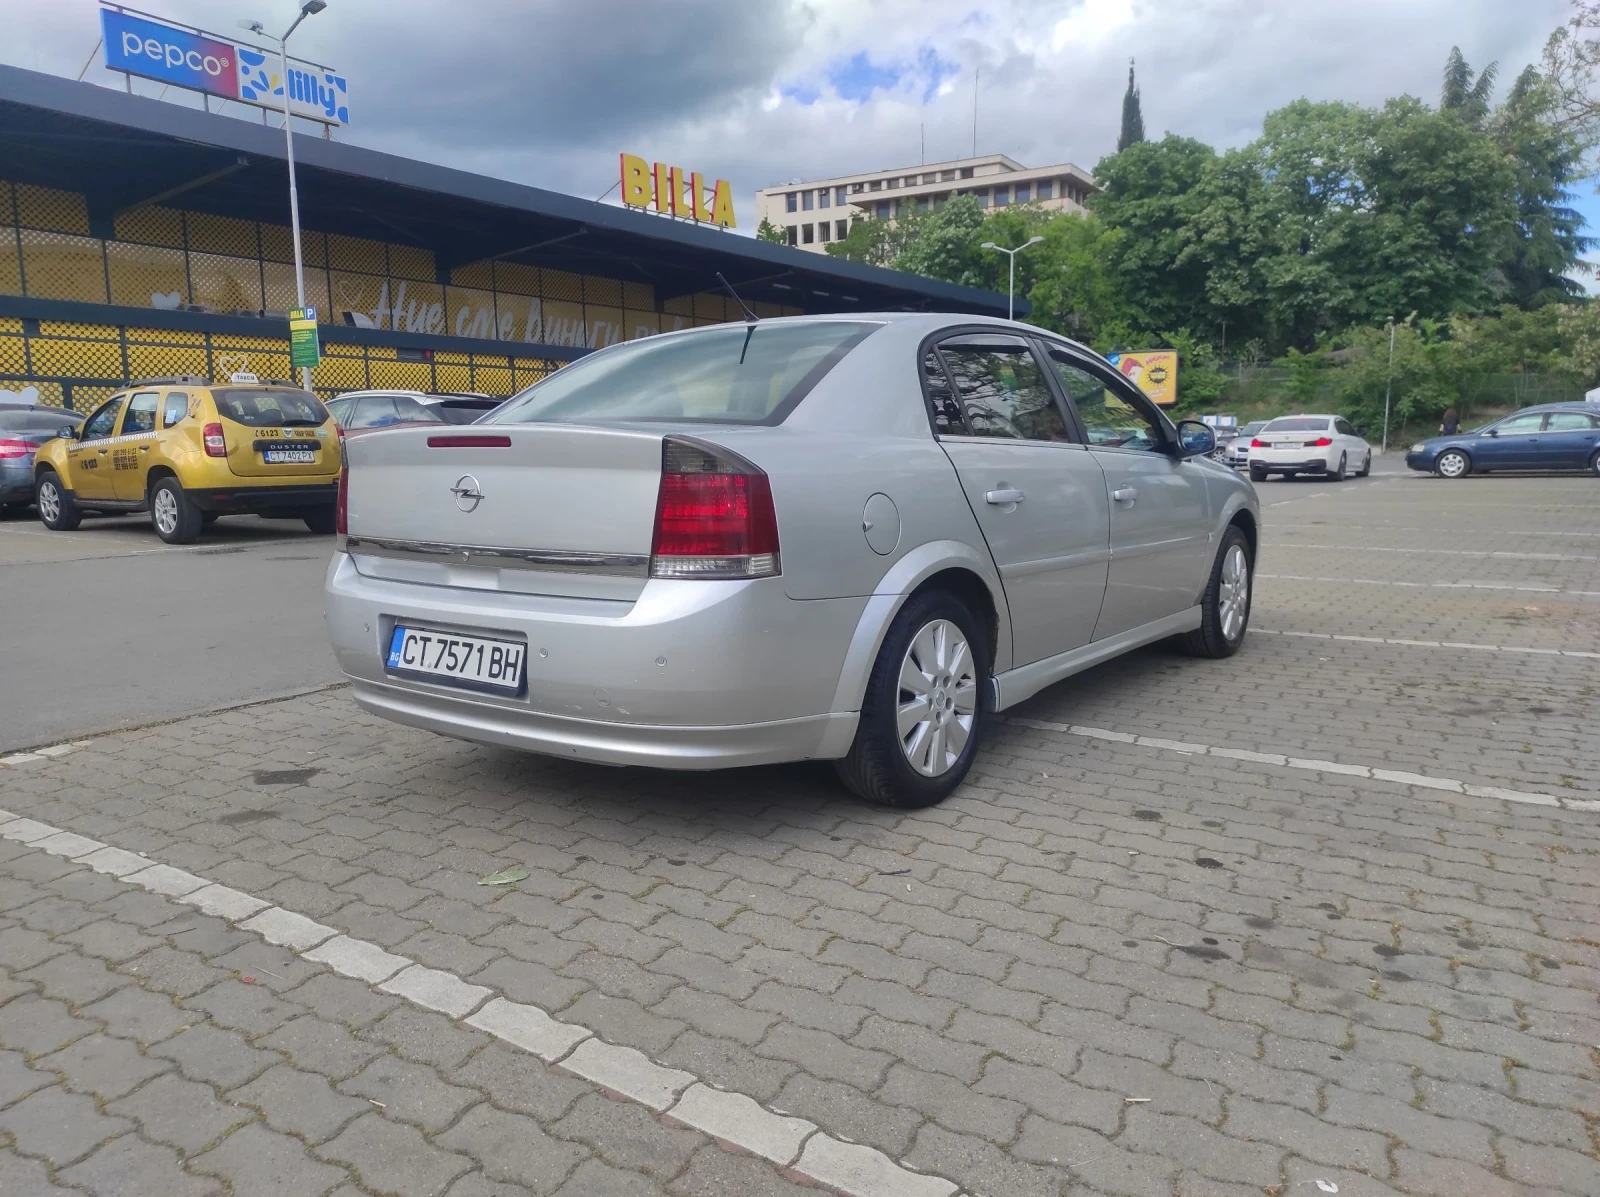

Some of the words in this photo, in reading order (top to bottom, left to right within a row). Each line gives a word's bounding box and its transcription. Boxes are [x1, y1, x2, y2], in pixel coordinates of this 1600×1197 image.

[287, 68, 335, 117] lilly
[620, 153, 736, 228] BILLA
[306, 309, 313, 318] P
[390, 652, 399, 661] BG
